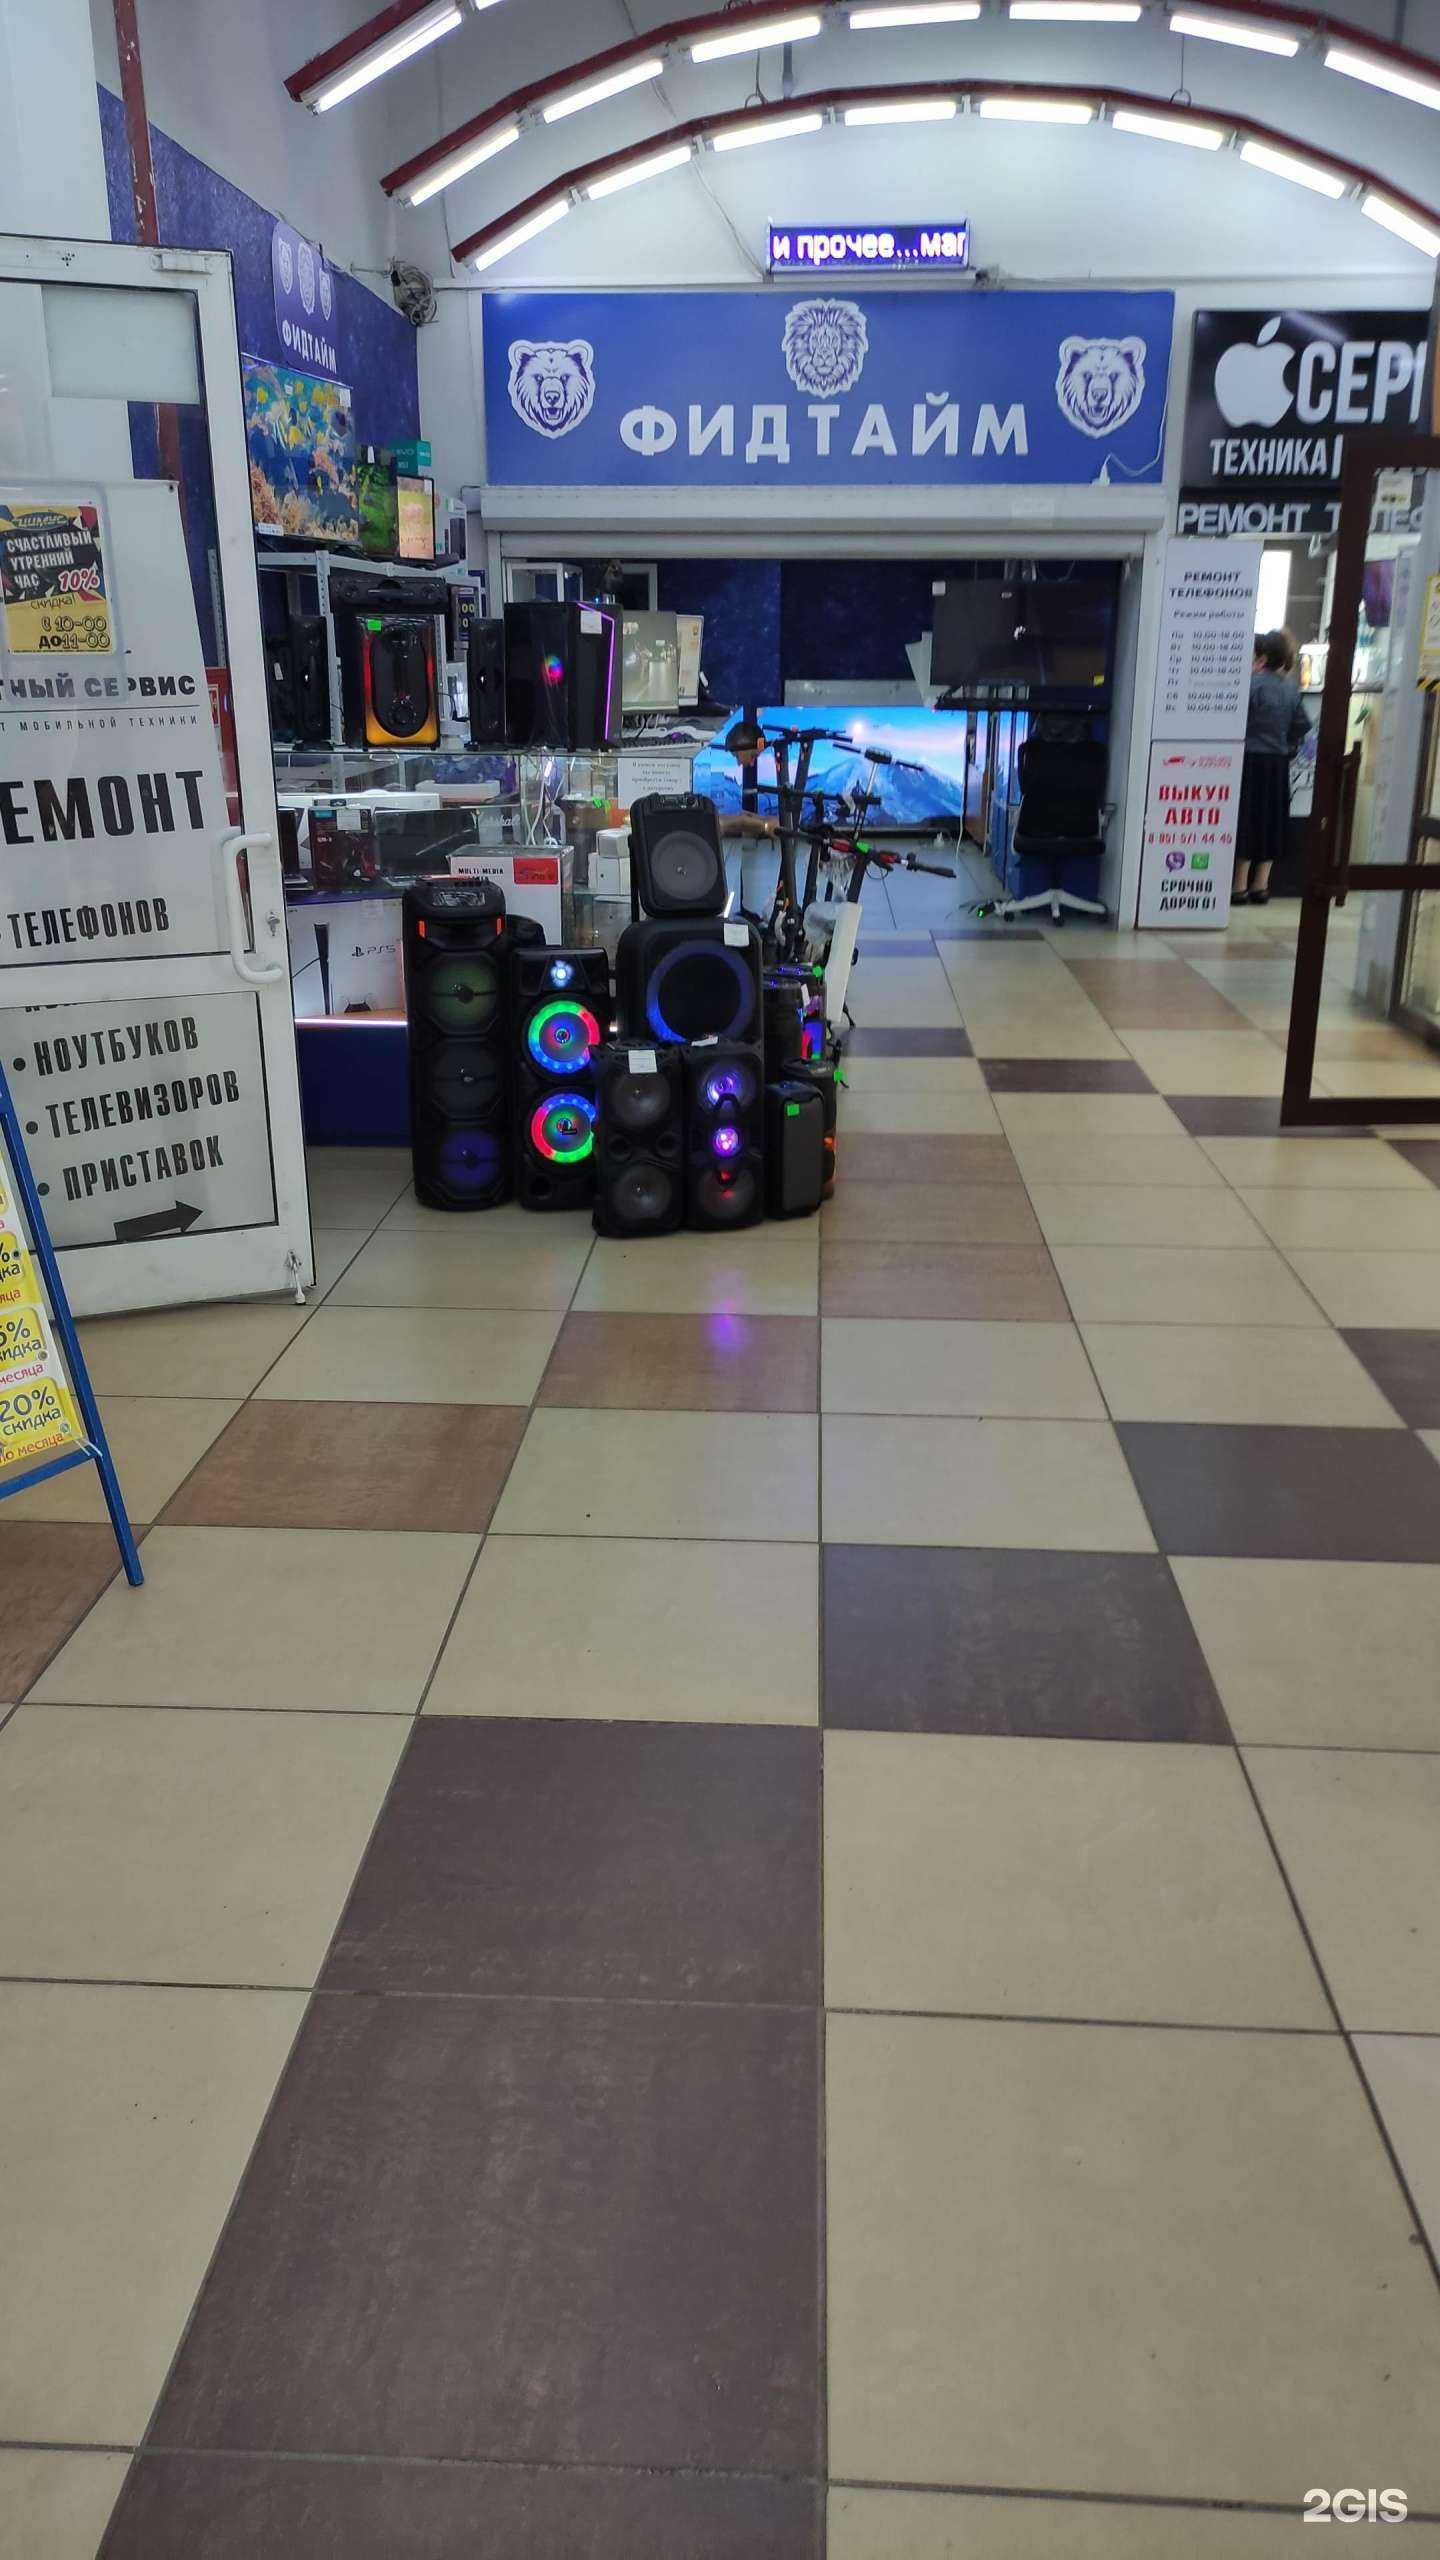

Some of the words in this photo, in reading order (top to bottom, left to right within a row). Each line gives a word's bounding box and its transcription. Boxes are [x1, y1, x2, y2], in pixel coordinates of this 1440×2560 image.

[773, 235, 790, 259] и
[282, 319, 337, 374] ФИДТАЙМ
[620, 391, 1029, 464] ФИДТАЙМ
[1210, 437, 1329, 477] ТЕХНИКА
[1177, 502, 1311, 533] РЕМОНТ
[6, 527, 93, 552] СЧАСТЛИВЫЙ
[11, 548, 75, 571] УТРЕННИЙ
[14, 573, 40, 589] ЧАС
[58, 568, 101, 592] 10%
[1184, 571, 1243, 583] РЕМОНТ
[1169, 586, 1253, 599] ТЕЛЕФОНОВ
[54, 615, 107, 632] 10-00
[84, 674, 196, 698] СЕРВИС
[19, 716, 118, 732] МОБИЛЬНОЙ
[129, 715, 199, 728] ТЕХНИКИ
[1159, 784, 1231, 801] ВЫКУП
[1164, 807, 1221, 826] АВТО
[1160, 879, 1213, 893] СРОЧНО
[7, 897, 170, 949] ТЕЛЕФОНОВ
[367, 944, 396, 955] PS5
[34, 1016, 199, 1076] НОУТБУКОВ
[45, 1070, 240, 1139] ТЕЛЕВИЗОРОВ
[63, 1135, 224, 1201] ПРИСТАВОК
[0, 1386, 56, 1423] 20%
[3, 1408, 62, 1436] скидка
[17, 1432, 65, 1457] месяца
